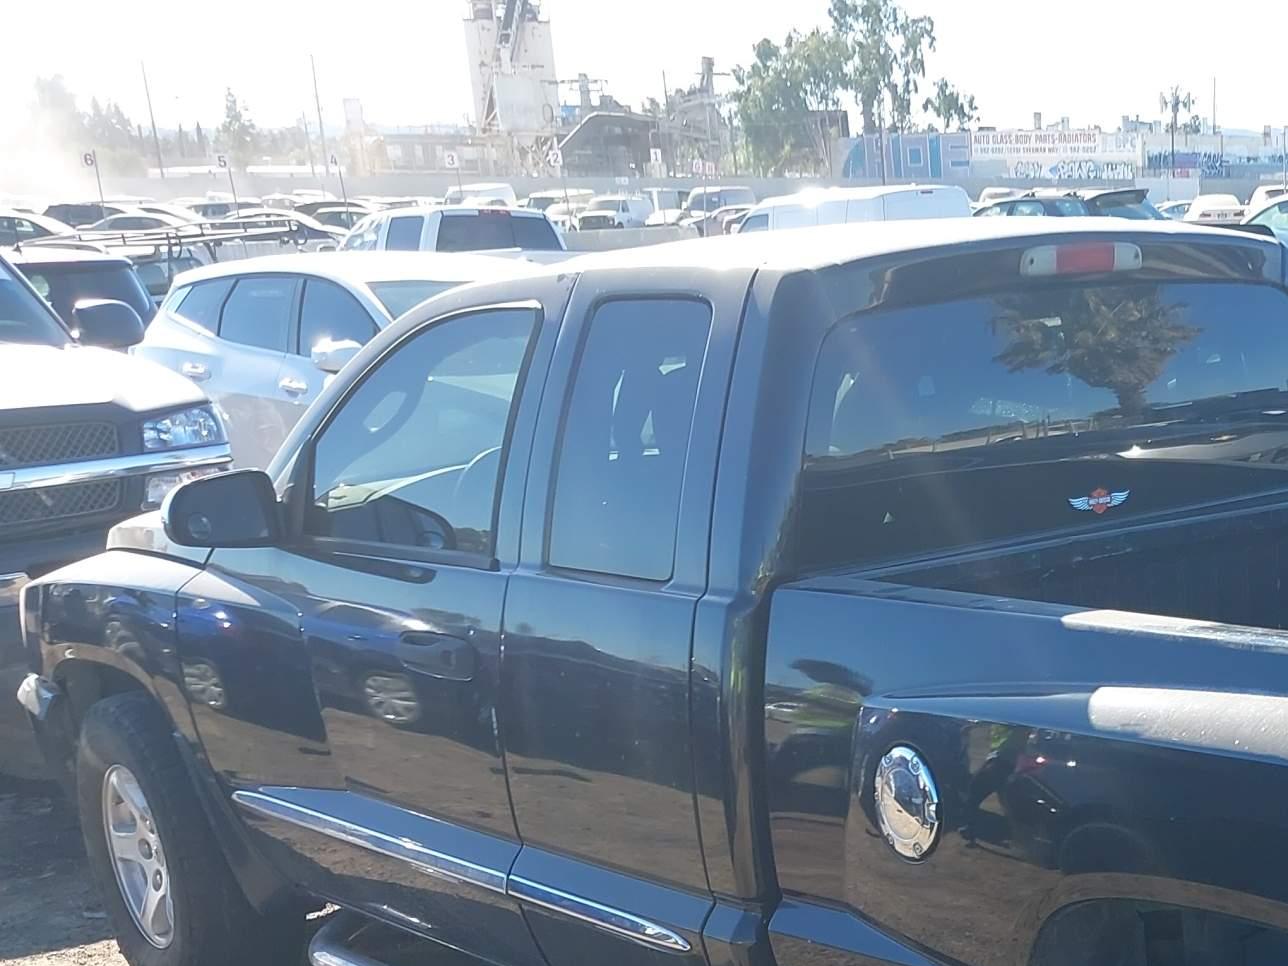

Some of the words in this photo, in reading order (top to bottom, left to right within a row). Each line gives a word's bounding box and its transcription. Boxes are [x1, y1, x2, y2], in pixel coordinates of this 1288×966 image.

[973, 133, 990, 145] AUTO
[83, 153, 95, 166] 6
[217, 155, 227, 168] 5
[330, 154, 338, 166] 4
[446, 154, 455, 166] 3
[551, 153, 560, 165] 2
